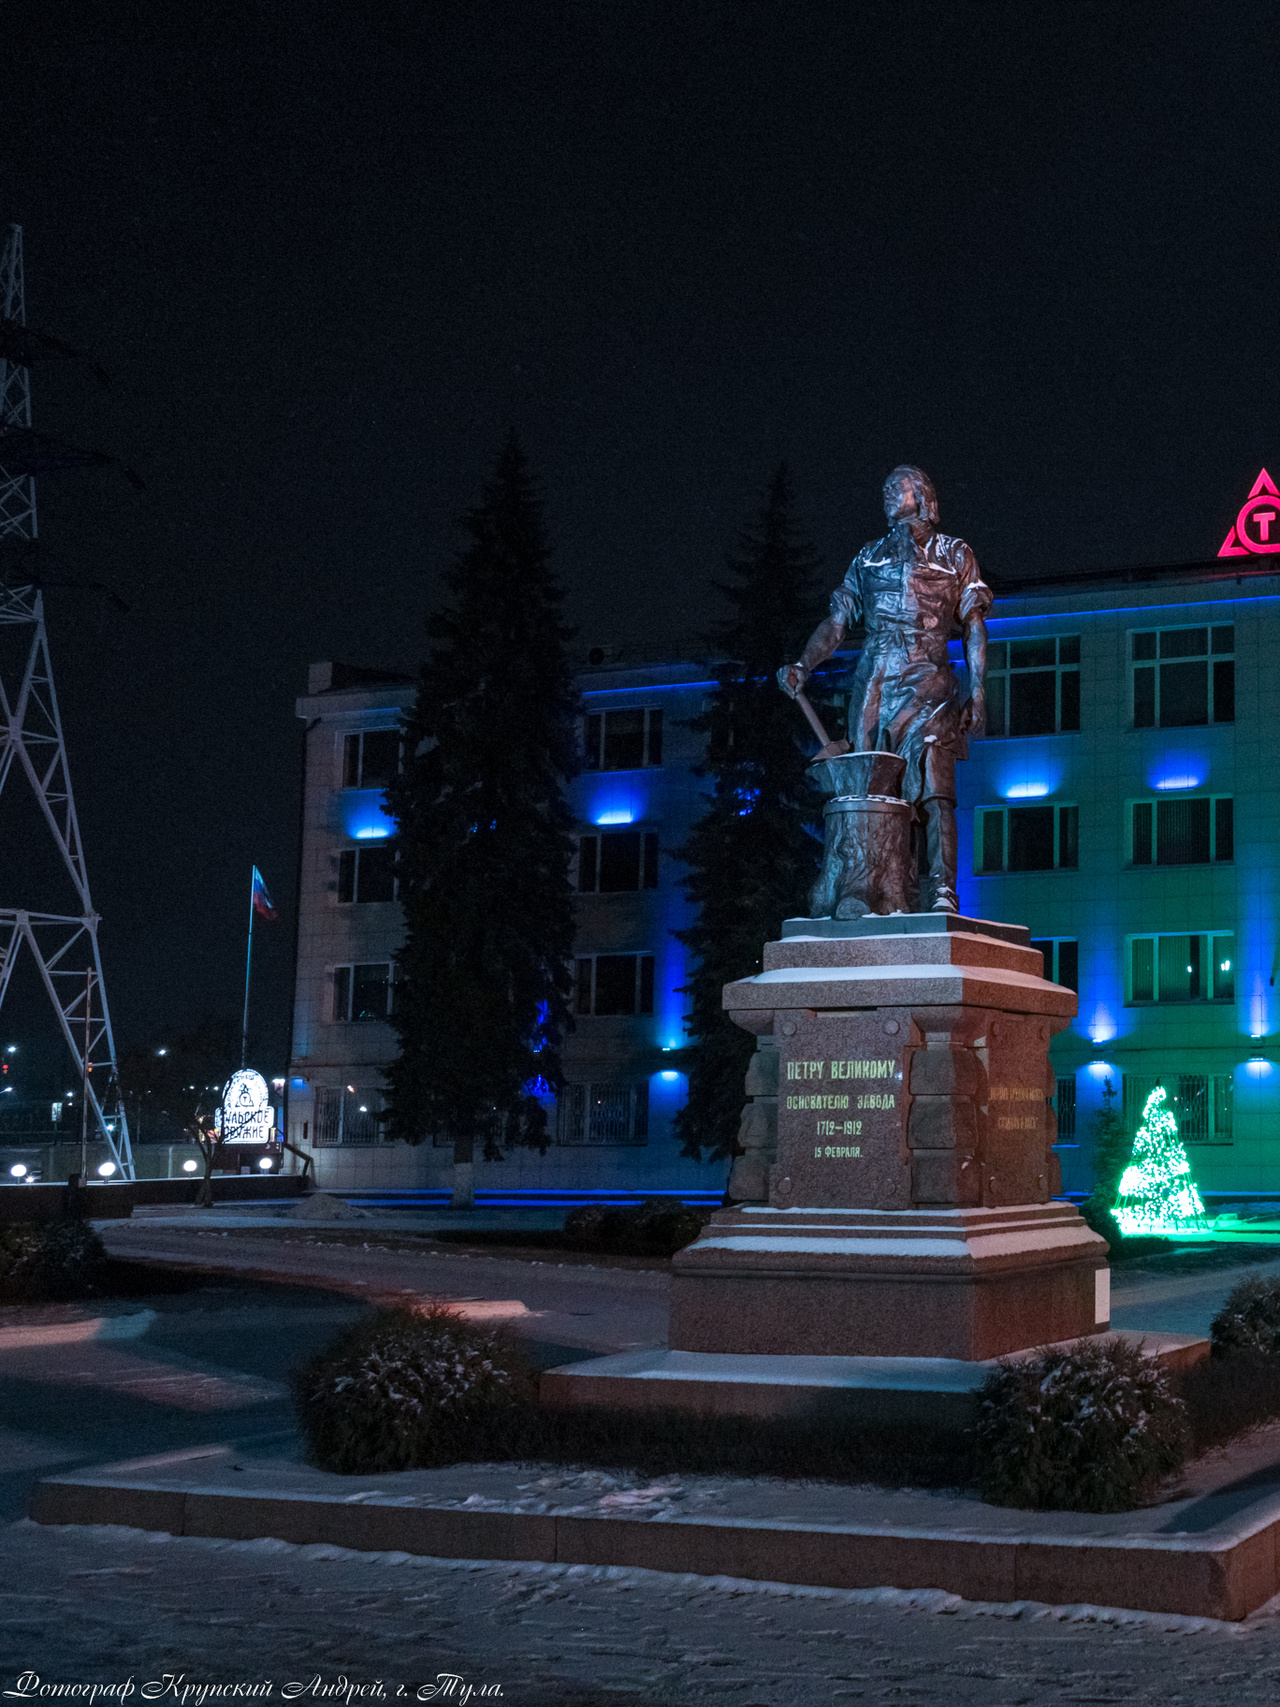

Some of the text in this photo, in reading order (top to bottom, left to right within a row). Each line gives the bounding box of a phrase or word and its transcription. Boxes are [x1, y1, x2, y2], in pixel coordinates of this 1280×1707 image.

[787, 1060, 895, 1080] ПЕТРУ ВЕЛИКОМУ
[786, 1094, 895, 1110] ОСНОВАТЕЛЮ ЗАВОДА
[216, 1109, 269, 1125] УЛЬСКОЕ
[814, 1147, 822, 1158] 15
